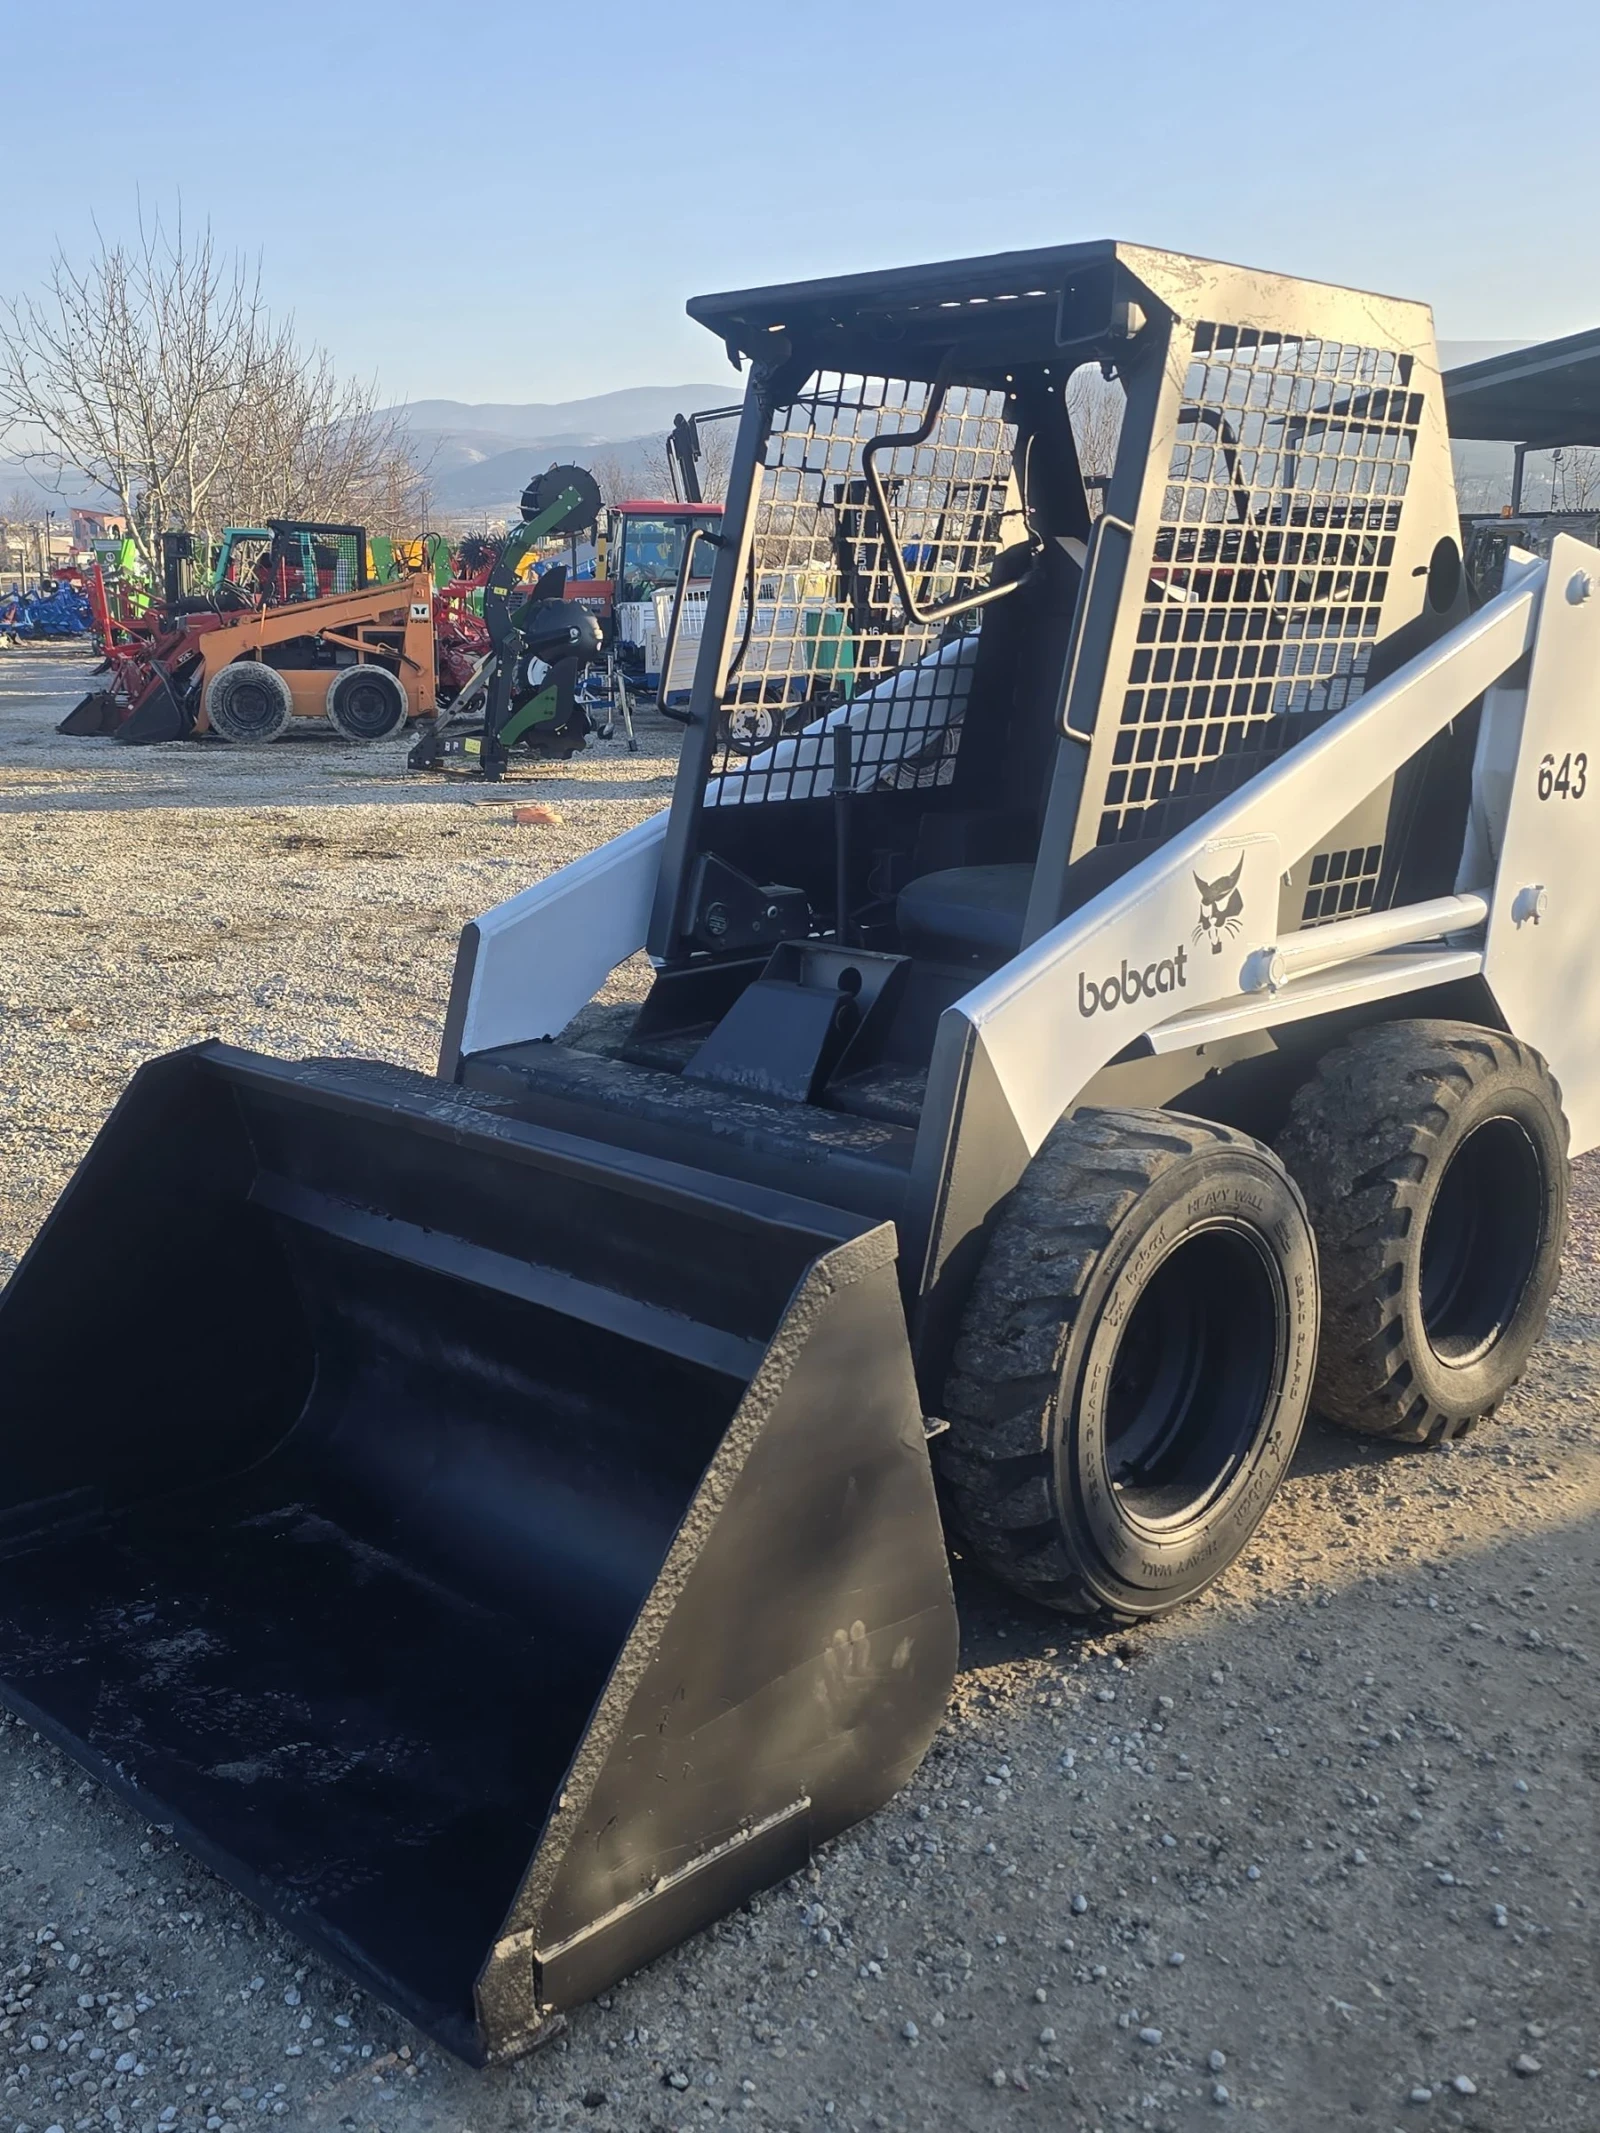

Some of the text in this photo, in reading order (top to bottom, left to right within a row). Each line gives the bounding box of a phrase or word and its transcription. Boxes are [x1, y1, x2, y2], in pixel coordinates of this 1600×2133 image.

[1538, 752, 1587, 801] 643
[1078, 944, 1187, 1018] bobcat
[1187, 1189, 1230, 1215] HEAVY
[1234, 1189, 1264, 1211] WALL
[1125, 1225, 1168, 1286] bobcat
[1141, 1558, 1172, 1577] WALL
